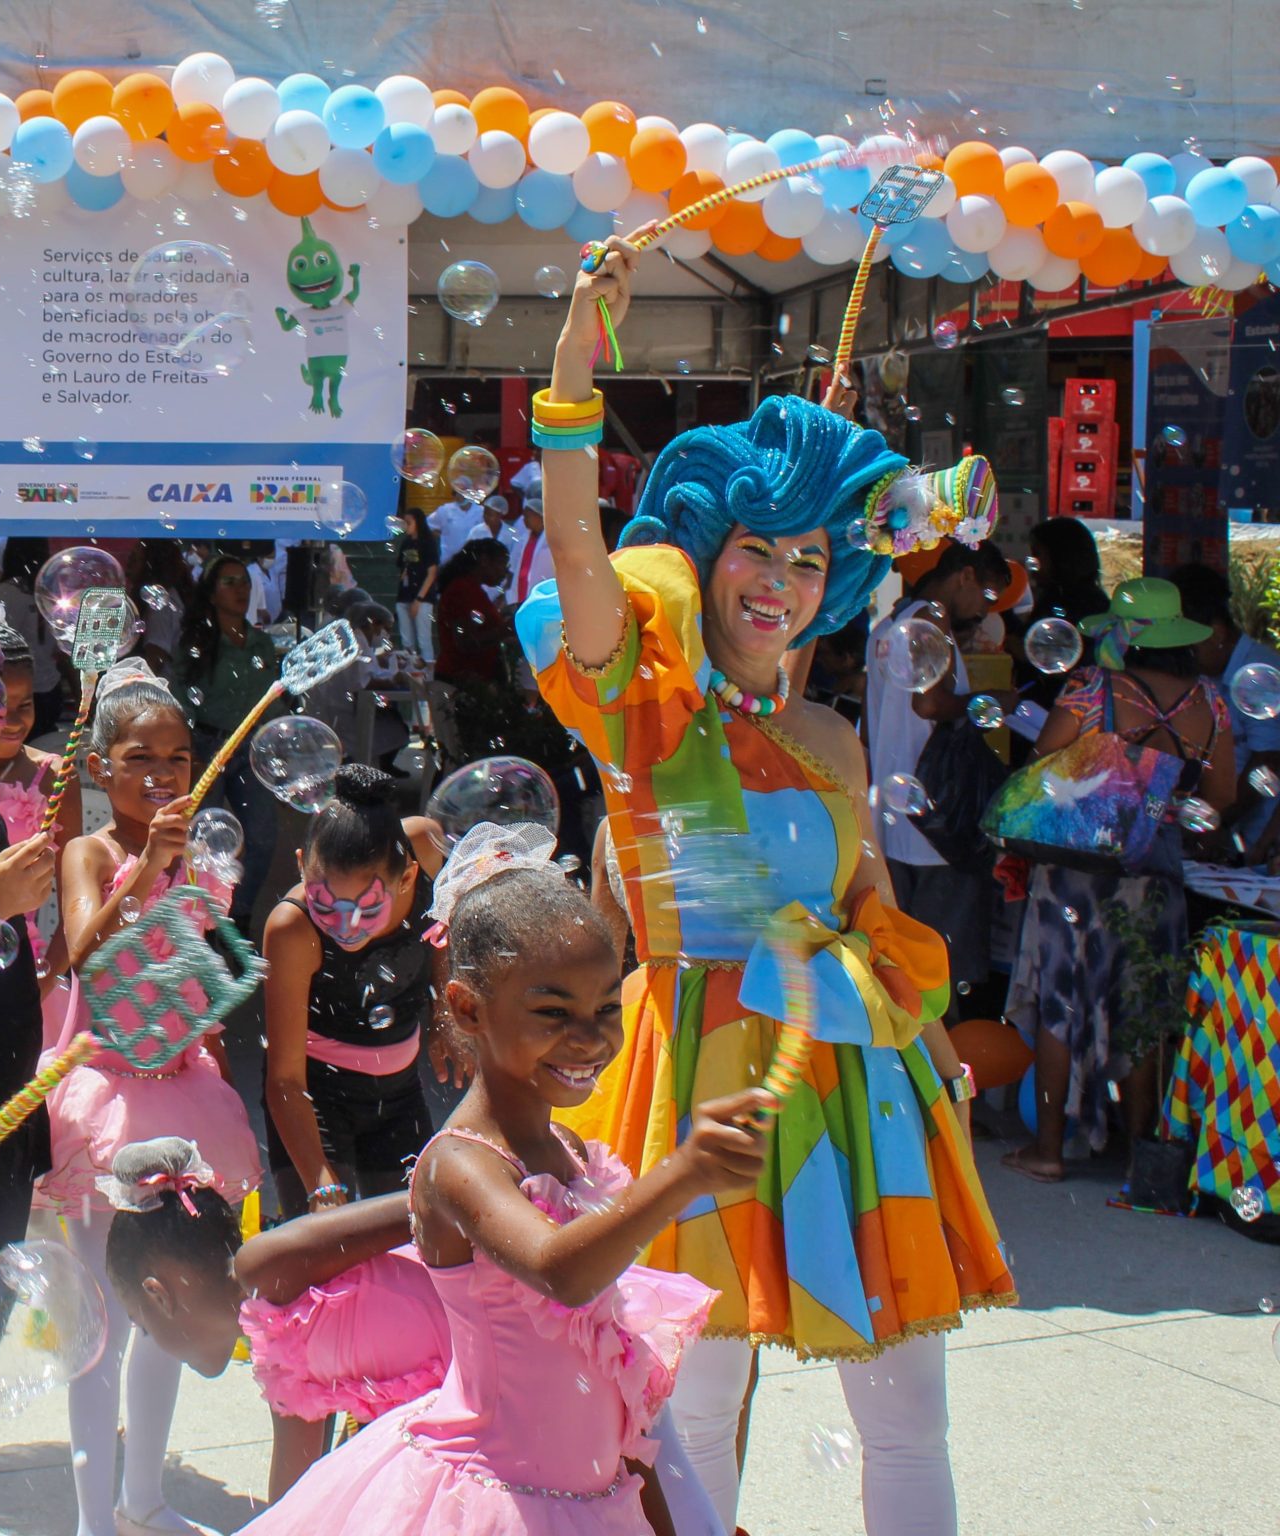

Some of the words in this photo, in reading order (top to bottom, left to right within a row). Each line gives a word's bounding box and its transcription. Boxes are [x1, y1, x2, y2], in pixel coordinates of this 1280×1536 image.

[43, 249, 113, 265] Serviços
[118, 249, 140, 263] de
[43, 269, 105, 284] cultura,
[154, 272, 166, 283] e
[170, 269, 250, 284] cidadania
[42, 291, 80, 306] para
[84, 291, 104, 303] os
[109, 289, 198, 303] moradores
[42, 309, 148, 324] beneficiados
[153, 309, 189, 326] pela
[42, 329, 64, 343] de
[210, 329, 233, 343] do
[42, 350, 113, 363] Governo
[118, 350, 140, 363] do
[145, 350, 203, 363] Estado
[42, 374, 68, 384] em
[73, 370, 120, 384] Lauro
[125, 370, 147, 384] de
[152, 370, 208, 384] Freitas
[42, 392, 52, 403] e
[57, 389, 132, 404] Salvador.
[147, 483, 233, 503] CAIXA
[250, 483, 328, 503] BRASIL
